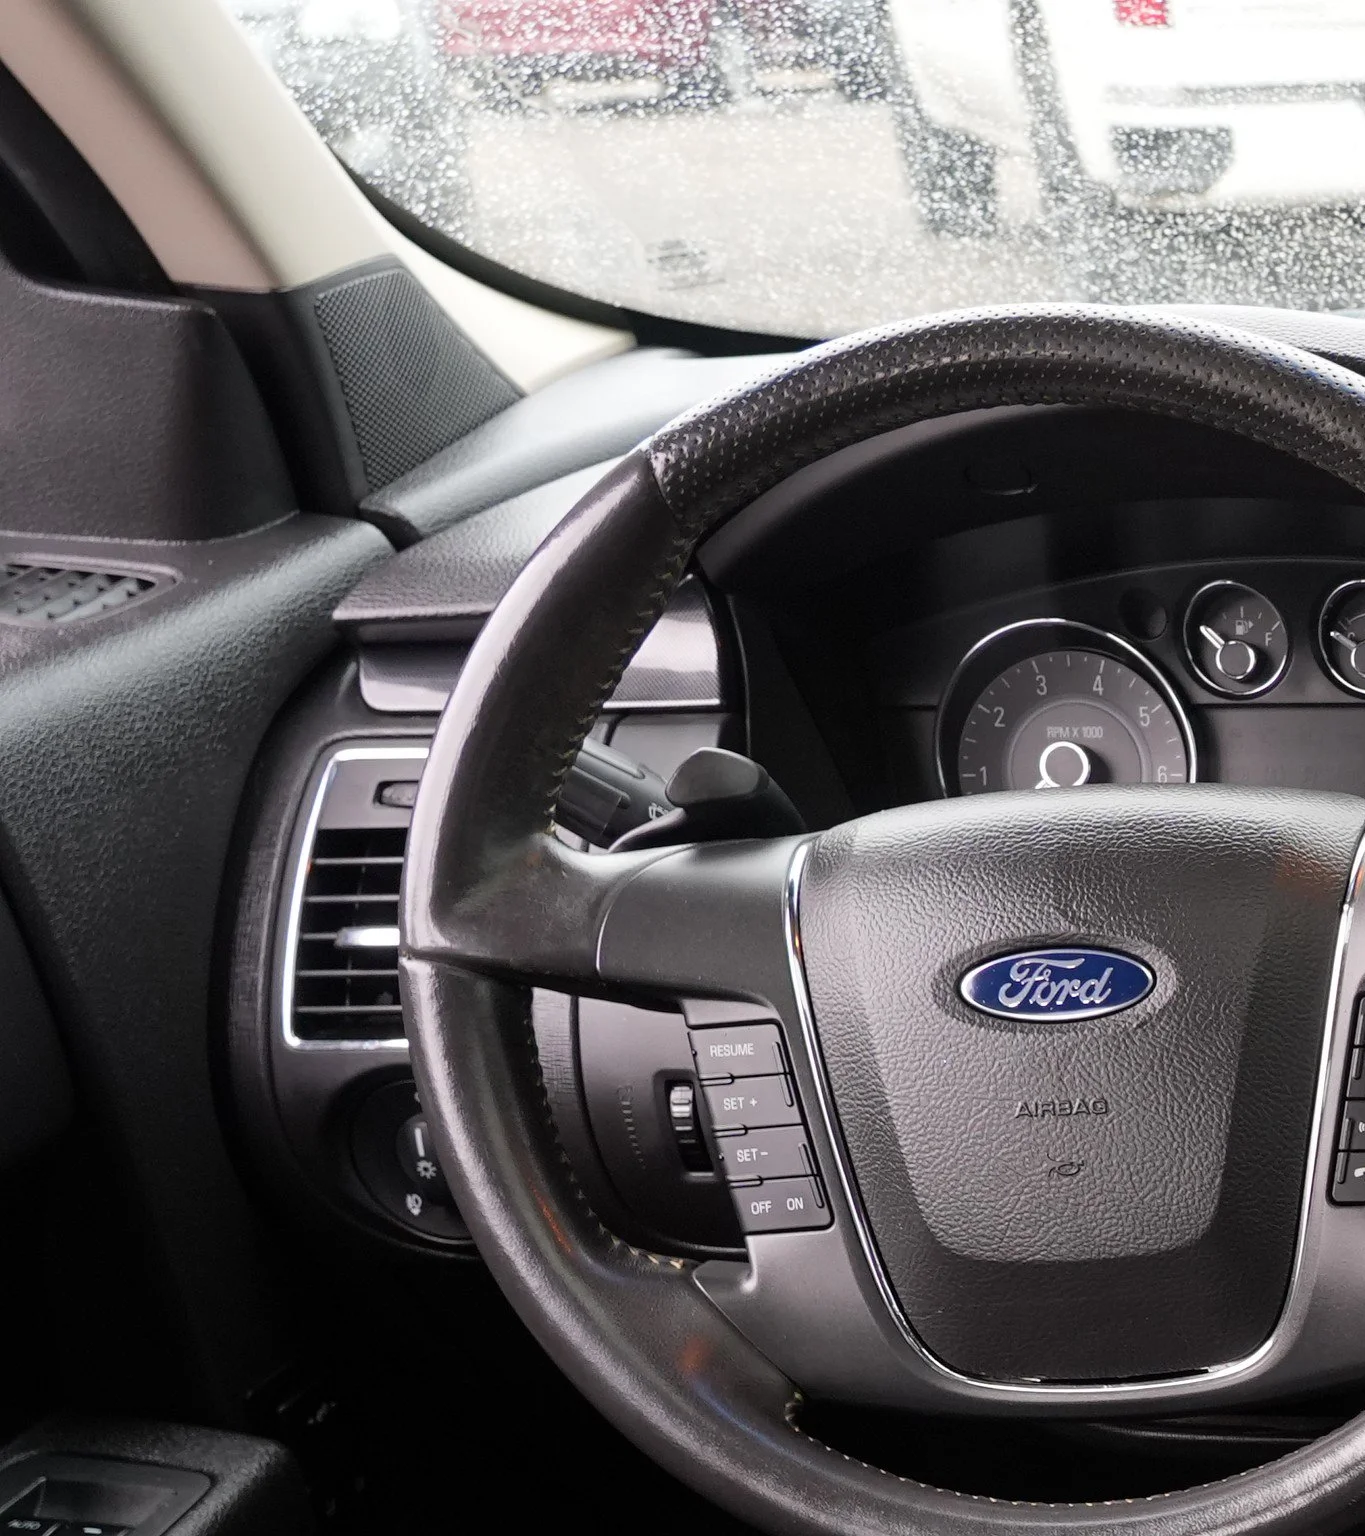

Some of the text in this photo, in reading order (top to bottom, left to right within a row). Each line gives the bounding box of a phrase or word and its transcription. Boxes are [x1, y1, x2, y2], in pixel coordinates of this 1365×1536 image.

[1265, 632, 1273, 646] F
[1036, 675, 1048, 696] 3
[1092, 674, 1104, 696] 4
[993, 706, 1006, 728] 2
[1139, 706, 1150, 727] 5
[1046, 726, 1070, 739] RPM
[1082, 726, 1104, 739] 1000
[979, 766, 988, 786] 1
[998, 957, 1115, 1008] Ford
[709, 1043, 755, 1058] RESUME
[723, 1097, 745, 1111] SET
[1015, 1098, 1110, 1119] AIRBAG
[750, 1197, 804, 1216] OFF ON
